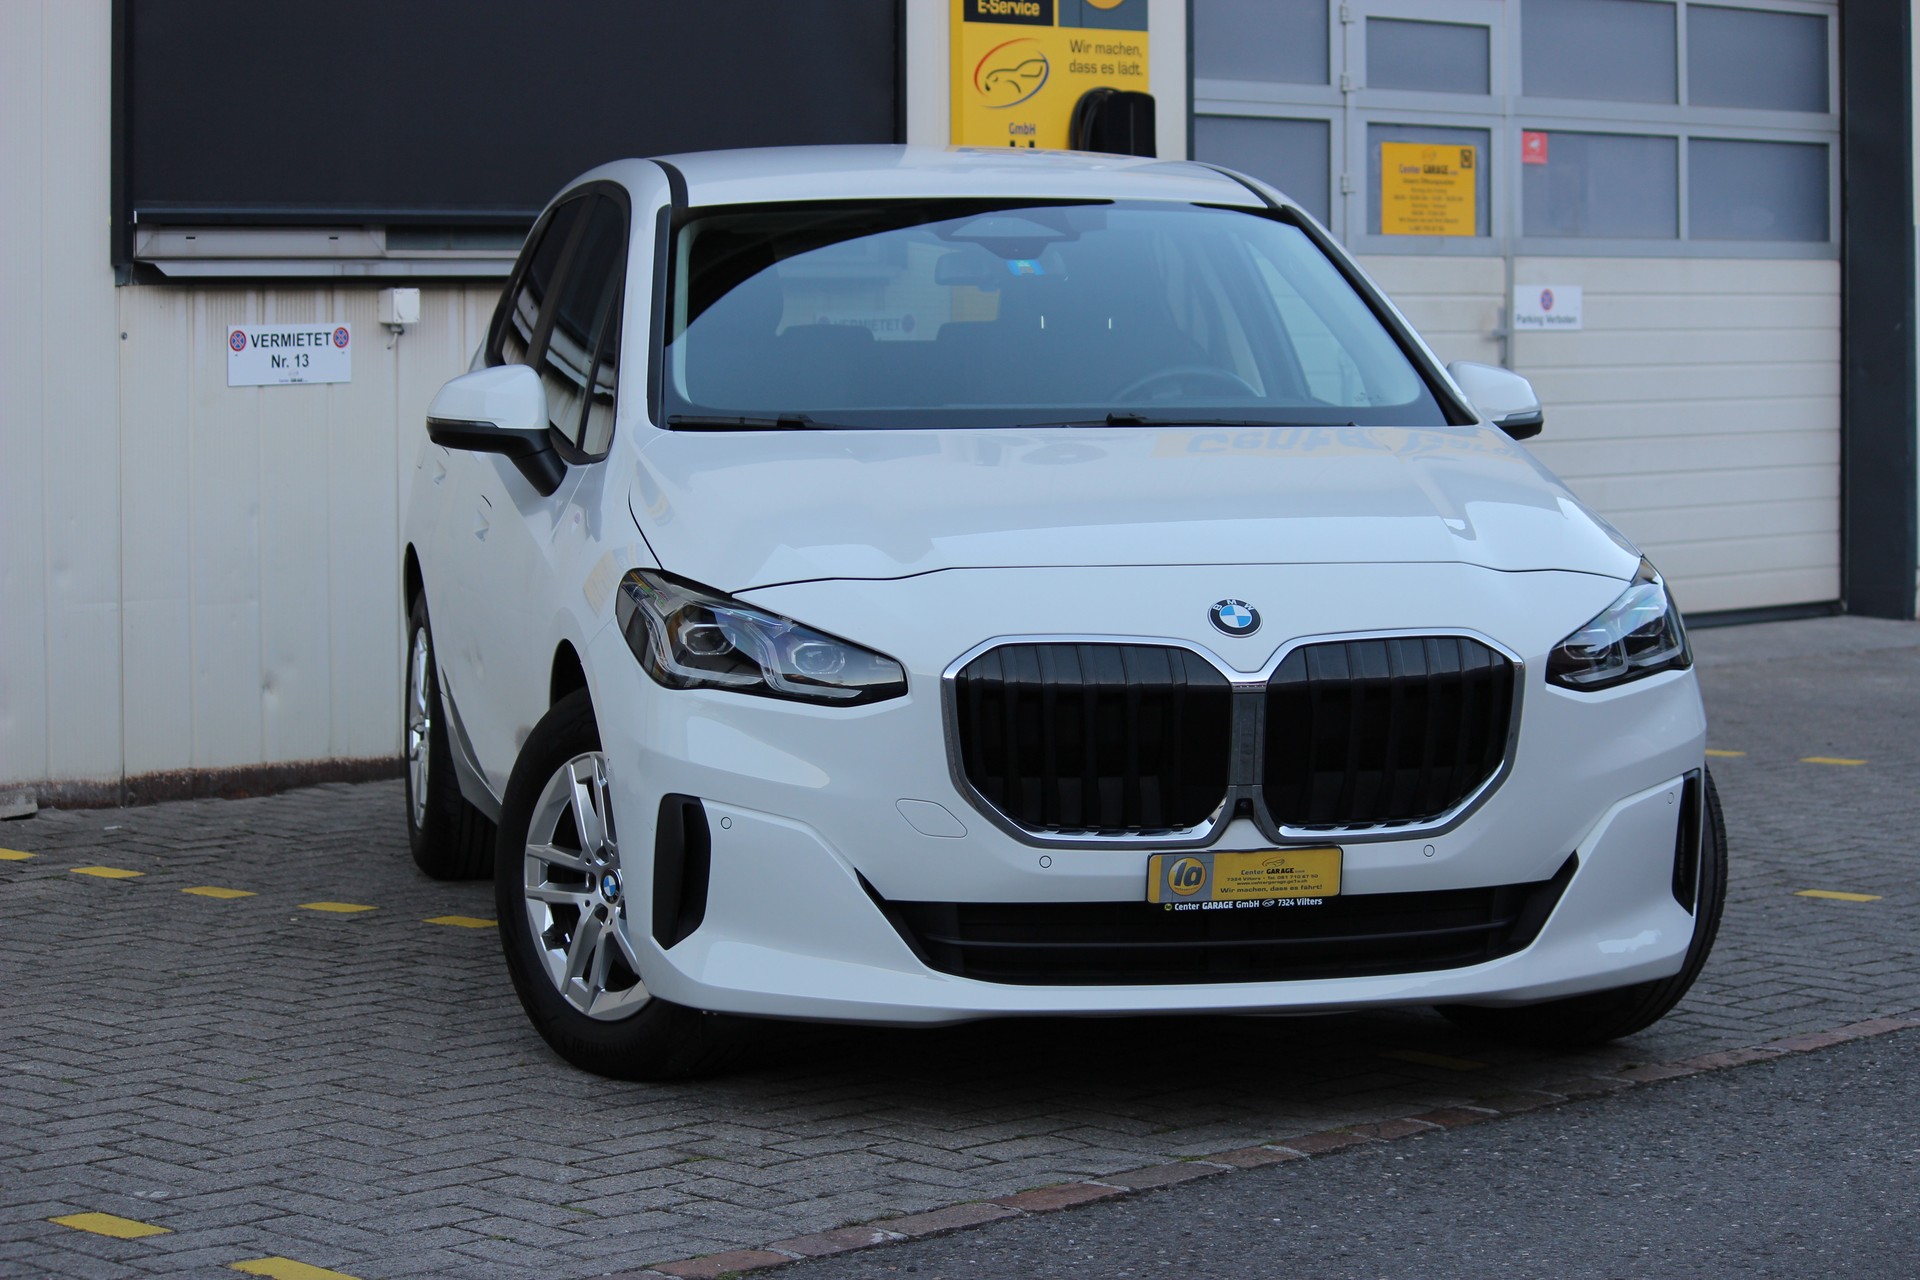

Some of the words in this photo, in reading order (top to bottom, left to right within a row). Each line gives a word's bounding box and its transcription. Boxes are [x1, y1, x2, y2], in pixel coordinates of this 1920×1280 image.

[977, 0, 1040, 17] E-Service
[1069, 39, 1092, 54] Wir
[1095, 43, 1143, 58] machen,
[1069, 58, 1097, 74] dass
[1101, 64, 1115, 75] es
[1008, 122, 1036, 135] GmbH
[250, 331, 332, 348] VERMIETET
[271, 354, 290, 369] Nr.
[294, 353, 310, 368] 13
[1212, 599, 1255, 611] BMW
[1240, 868, 1264, 876] Center
[1266, 867, 1295, 875] GARAGE
[1236, 885, 1268, 893] machen,
[1174, 903, 1200, 911] Center
[1202, 901, 1234, 910] GARAGE
[1235, 900, 1260, 908] GmbH
[1278, 899, 1295, 907] 7324
[1297, 897, 1323, 906] Vilters
